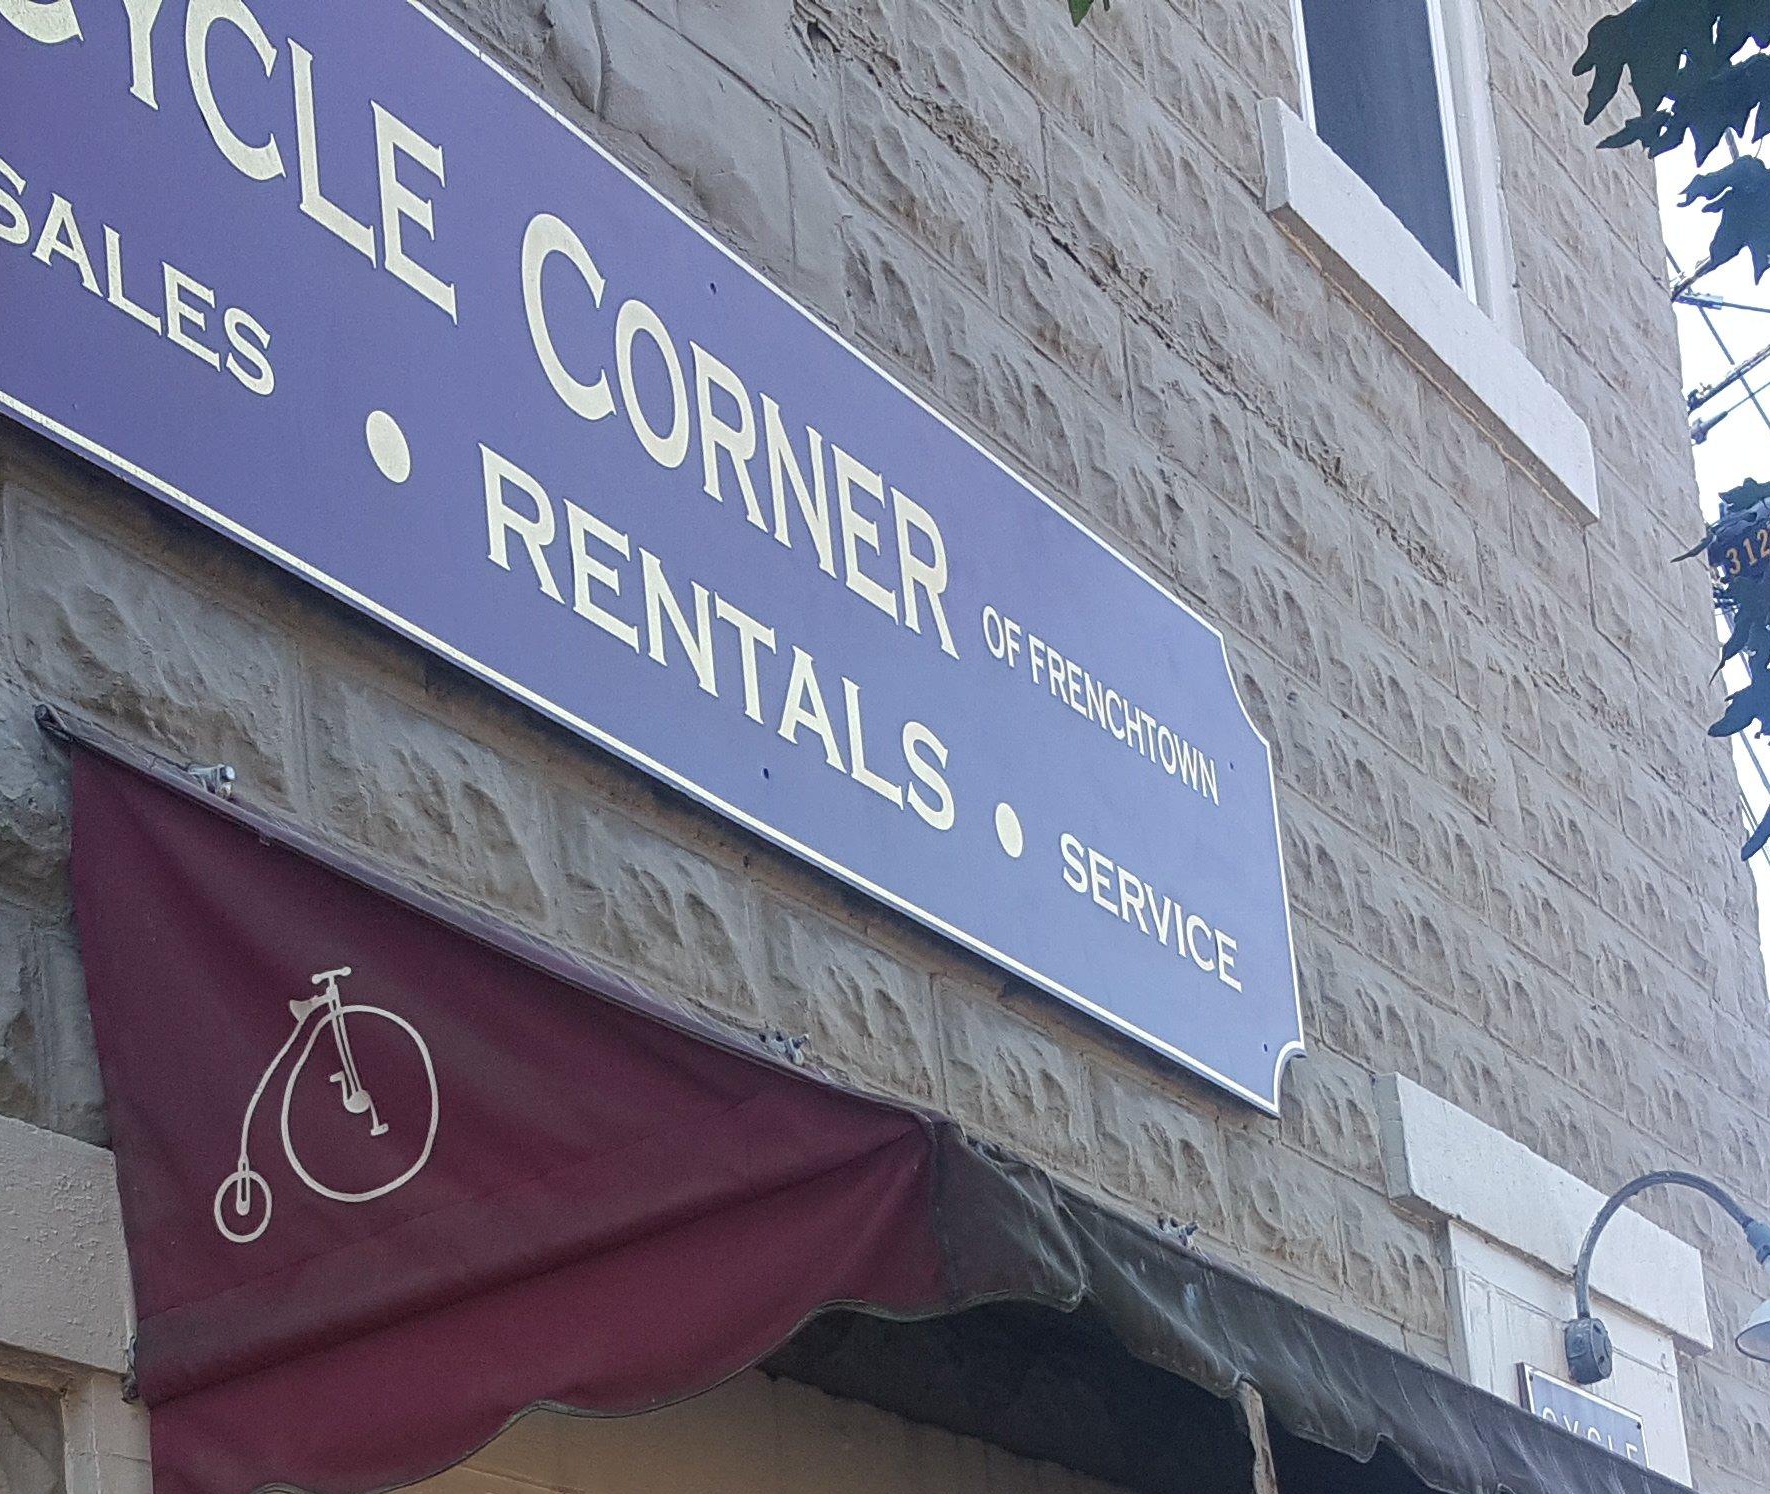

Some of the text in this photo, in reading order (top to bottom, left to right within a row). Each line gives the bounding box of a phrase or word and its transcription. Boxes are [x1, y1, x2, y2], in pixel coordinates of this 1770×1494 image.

[478, 442, 955, 831] RENTALS
[1059, 834, 1244, 993] SERVICE
[520, 213, 960, 660] CORNER
[983, 606, 1021, 669] OF
[1028, 633, 1219, 807] FRENCHTOWN
